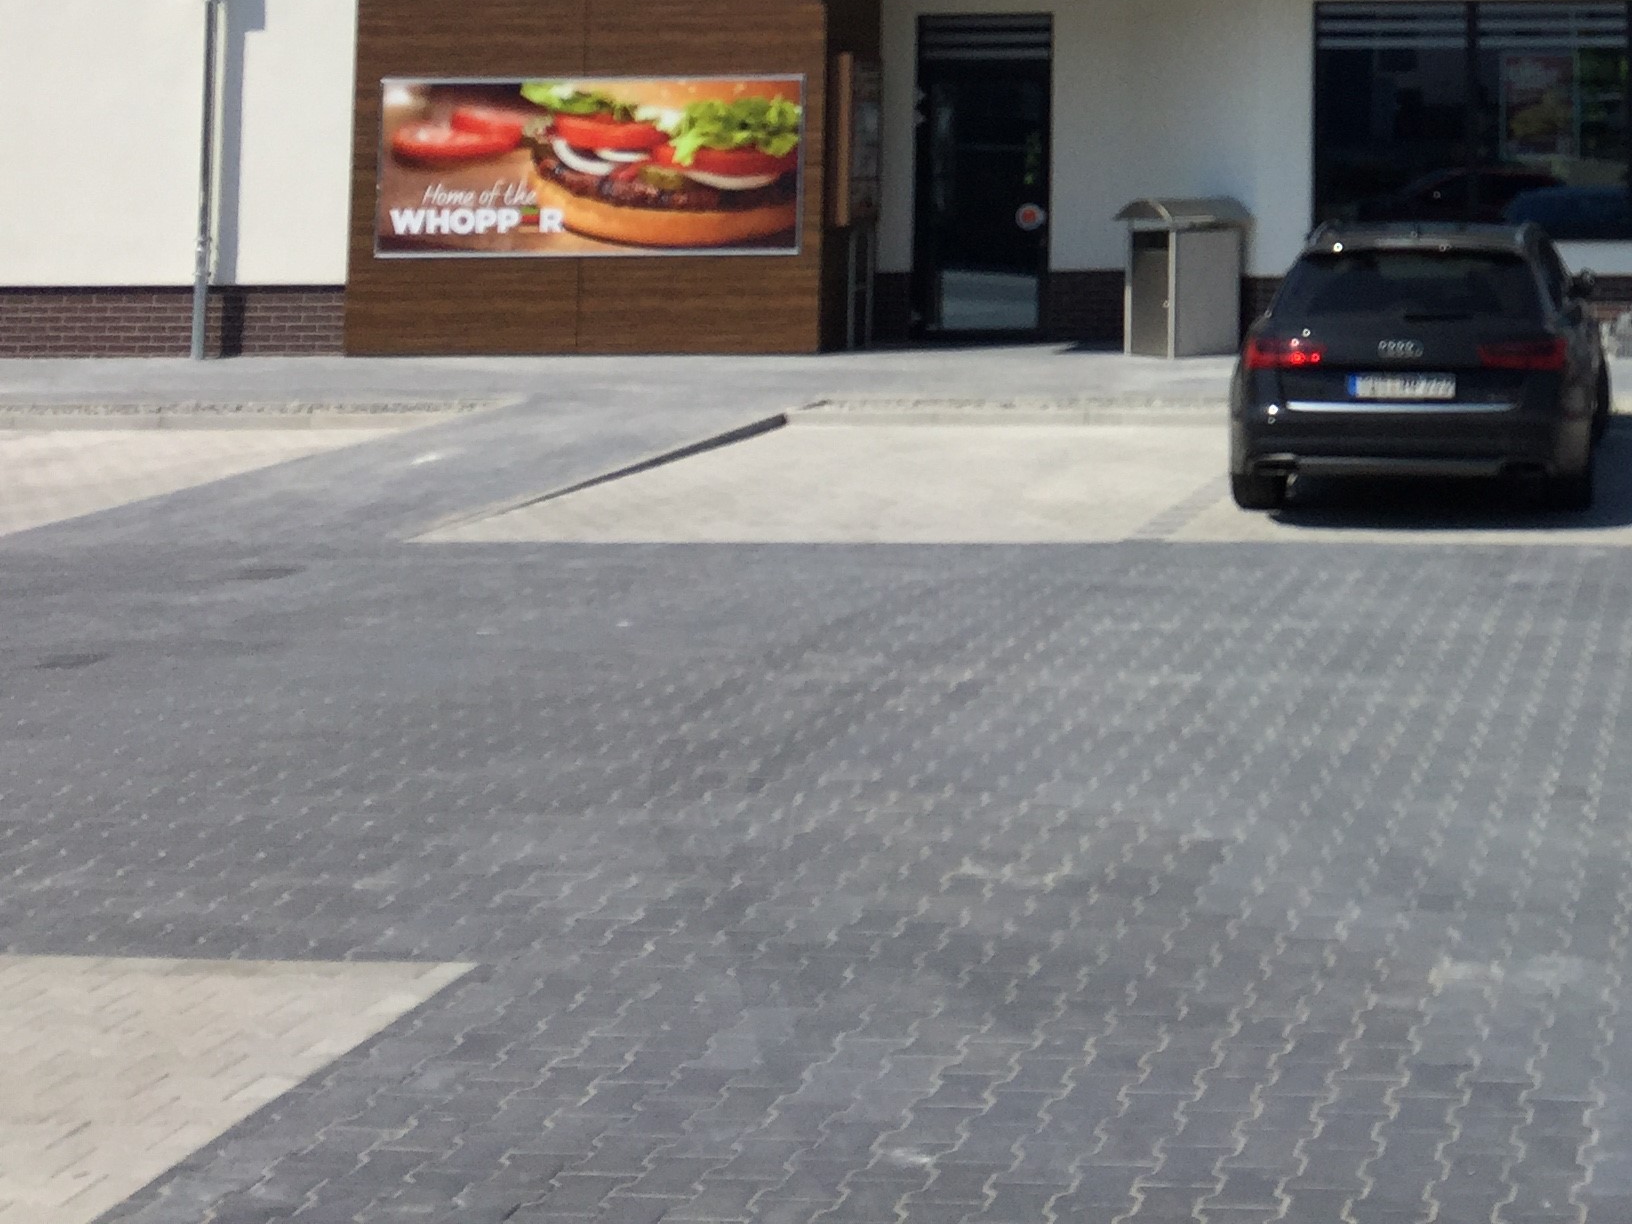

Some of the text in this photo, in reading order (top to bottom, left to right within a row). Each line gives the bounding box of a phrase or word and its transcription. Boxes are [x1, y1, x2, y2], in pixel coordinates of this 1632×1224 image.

[423, 178, 538, 208] Home of the
